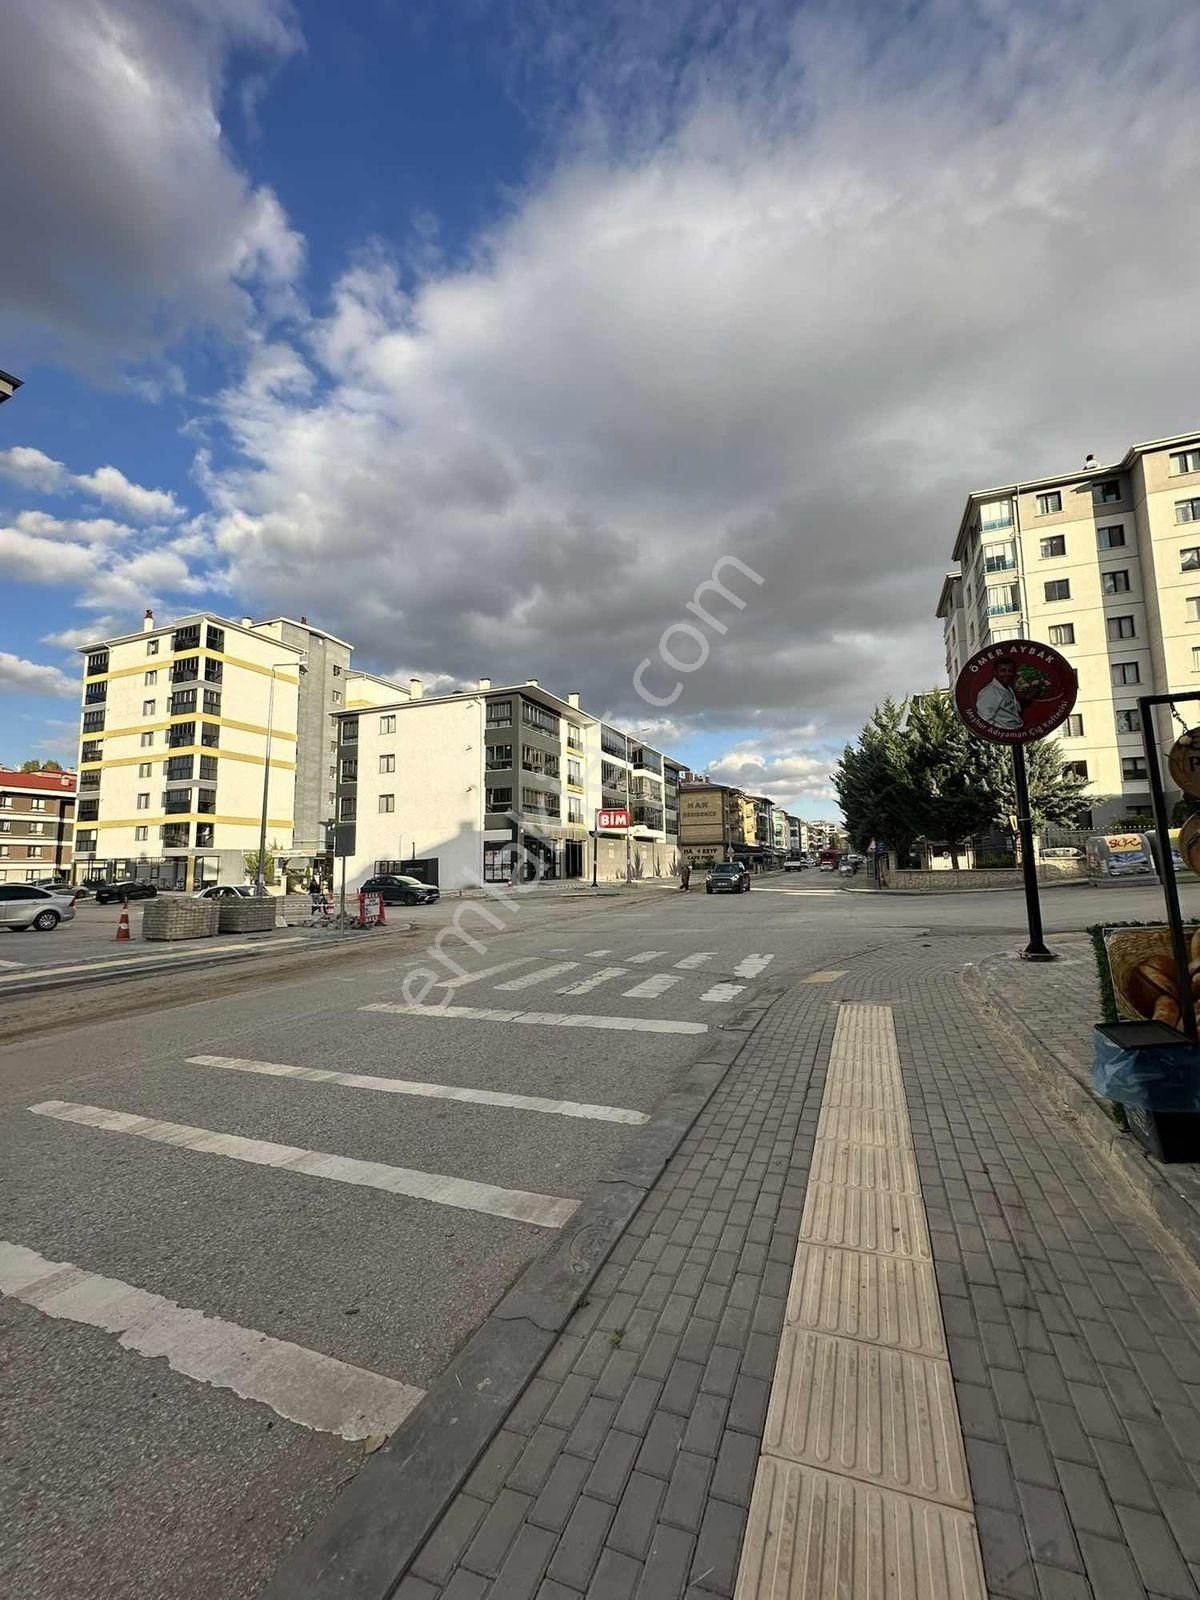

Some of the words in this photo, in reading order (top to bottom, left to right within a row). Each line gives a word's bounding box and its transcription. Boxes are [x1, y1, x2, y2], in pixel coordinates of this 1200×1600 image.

[969, 648, 1003, 673] ÖMER
[1010, 646, 1055, 664] AYBAK
[600, 811, 627, 826] BİM
